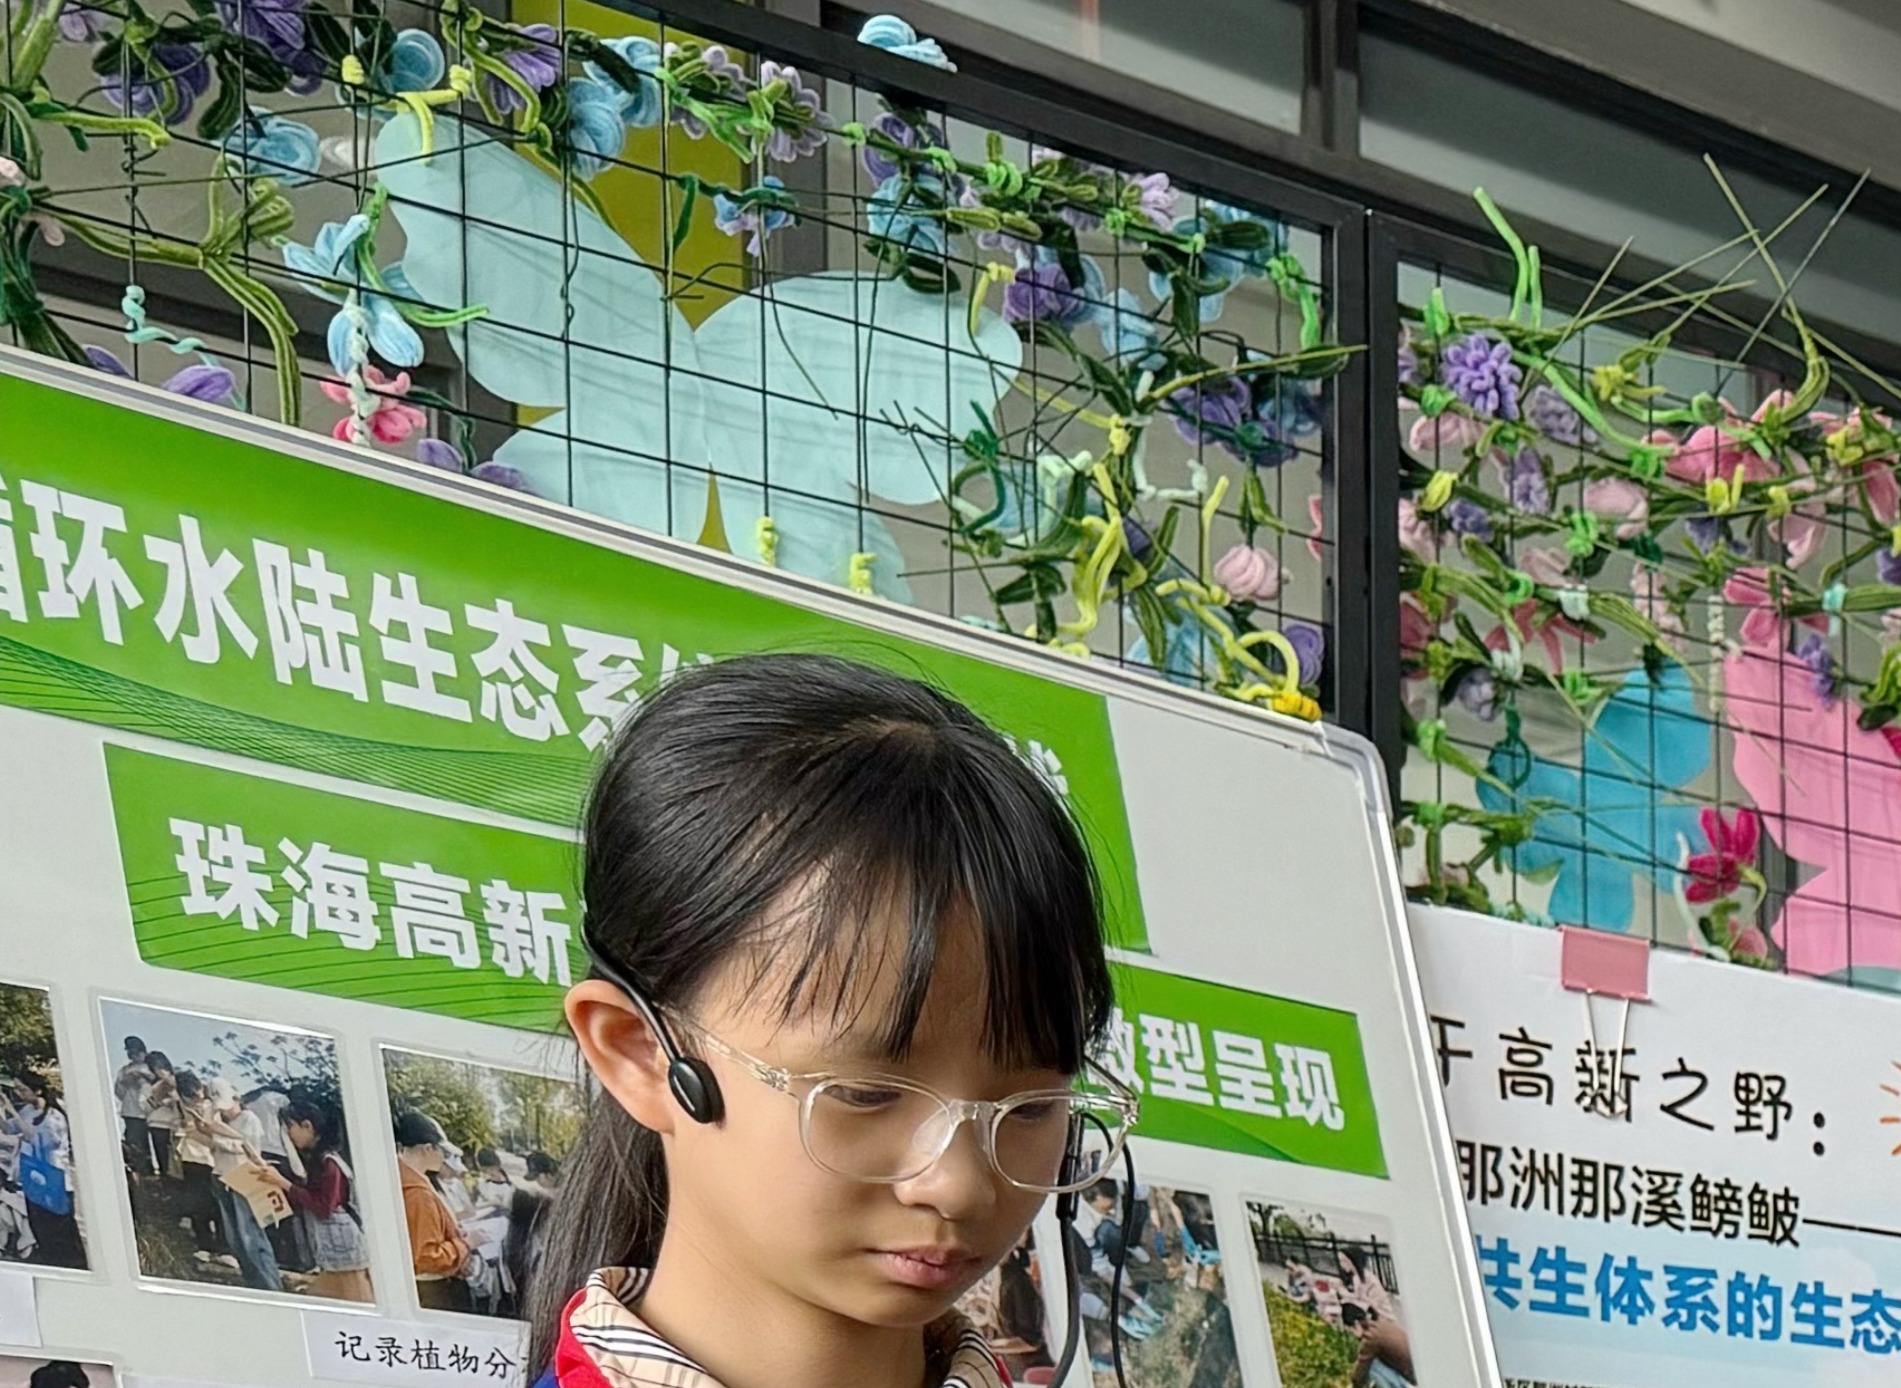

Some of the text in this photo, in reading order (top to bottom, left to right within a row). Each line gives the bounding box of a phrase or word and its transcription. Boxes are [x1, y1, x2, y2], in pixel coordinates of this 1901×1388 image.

[0, 470, 712, 756] 环水陆生态系
[170, 816, 574, 986] 珠海高新
[335, 1331, 528, 1379] 记录植物分
